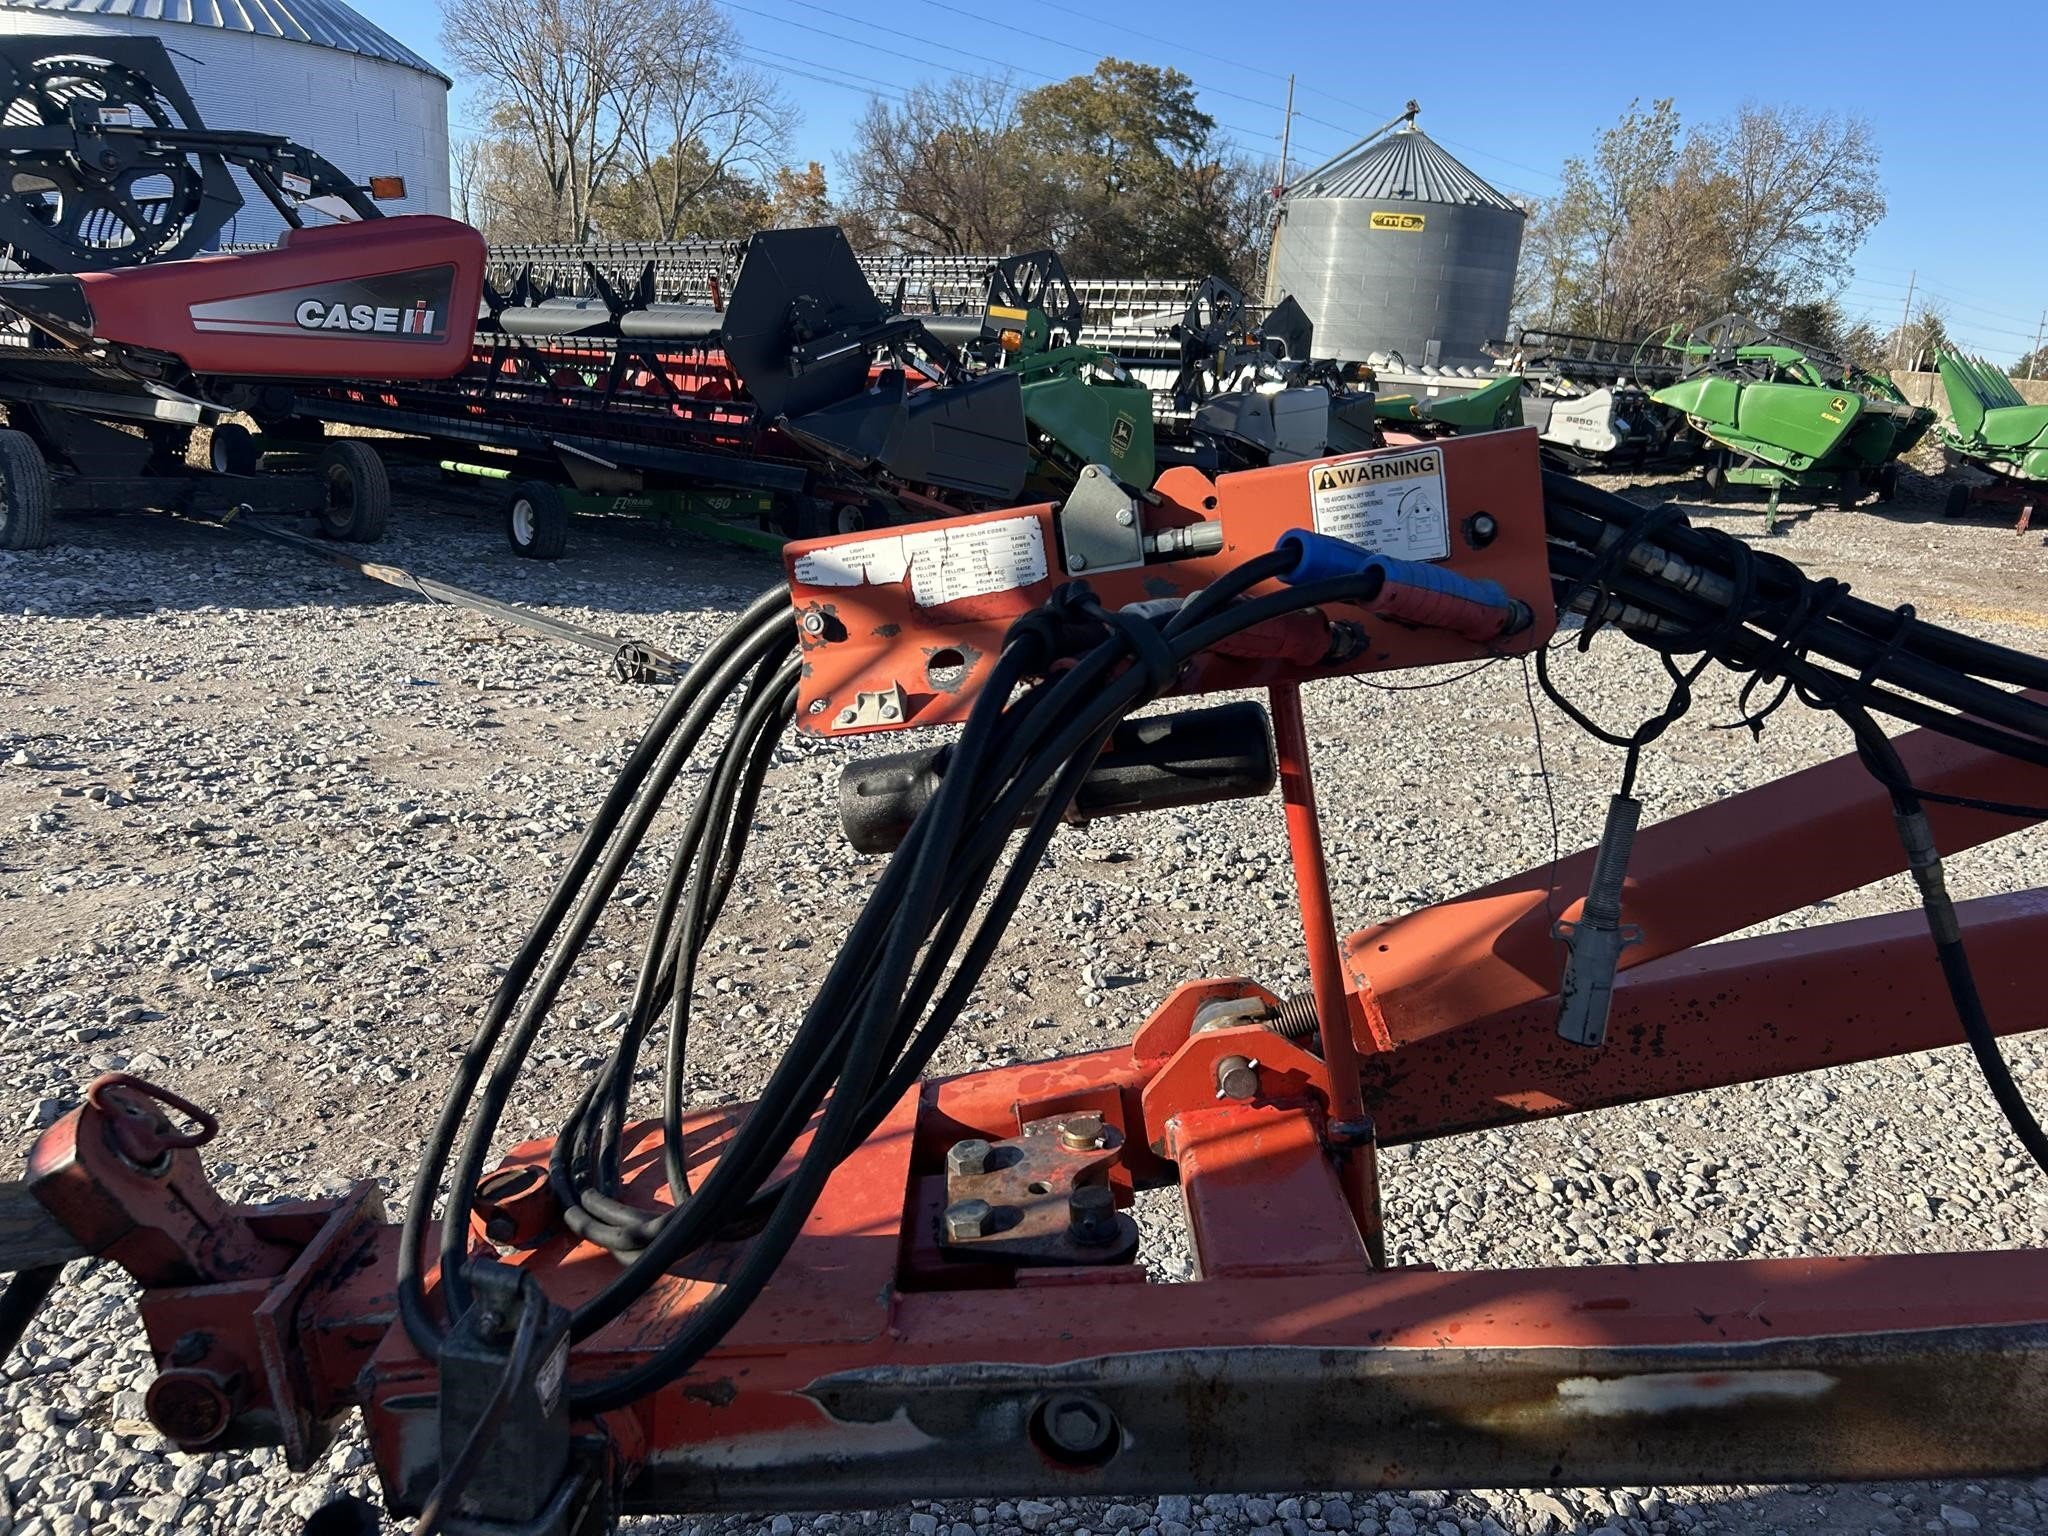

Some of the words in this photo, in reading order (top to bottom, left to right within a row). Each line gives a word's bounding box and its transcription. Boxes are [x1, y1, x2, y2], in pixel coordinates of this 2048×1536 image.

[296, 300, 400, 332] CASE
[1337, 456, 1435, 485] WARNING
[1331, 494, 1346, 503] AVOID
[1347, 491, 1364, 500] INJURY
[1365, 489, 1376, 498] DUE
[1326, 503, 1356, 513] ACCIDENTAL
[1357, 499, 1384, 508] LOWERING
[1338, 523, 1354, 531] LEVER
[1354, 521, 1362, 529] TO
[1361, 519, 1383, 528] LOCKED
[966, 529, 986, 539] COLOR
[1355, 529, 1375, 539] BEFORE
[970, 540, 989, 548] WHEEL
[1010, 534, 1027, 542] RAISE
[1011, 541, 1032, 550] LOWER
[849, 547, 865, 555] LIGHT
[1012, 549, 1029, 557] RAISE
[841, 552, 876, 563] RECEPTACLE
[916, 571, 938, 579] YELLOW
[944, 567, 966, 575] YELLOW
[1014, 556, 1034, 566] LOWER
[994, 568, 1006, 576] ACC
[995, 575, 1007, 583] ACC
[1016, 571, 1037, 581] LOWER
[920, 593, 935, 601] BLUE
